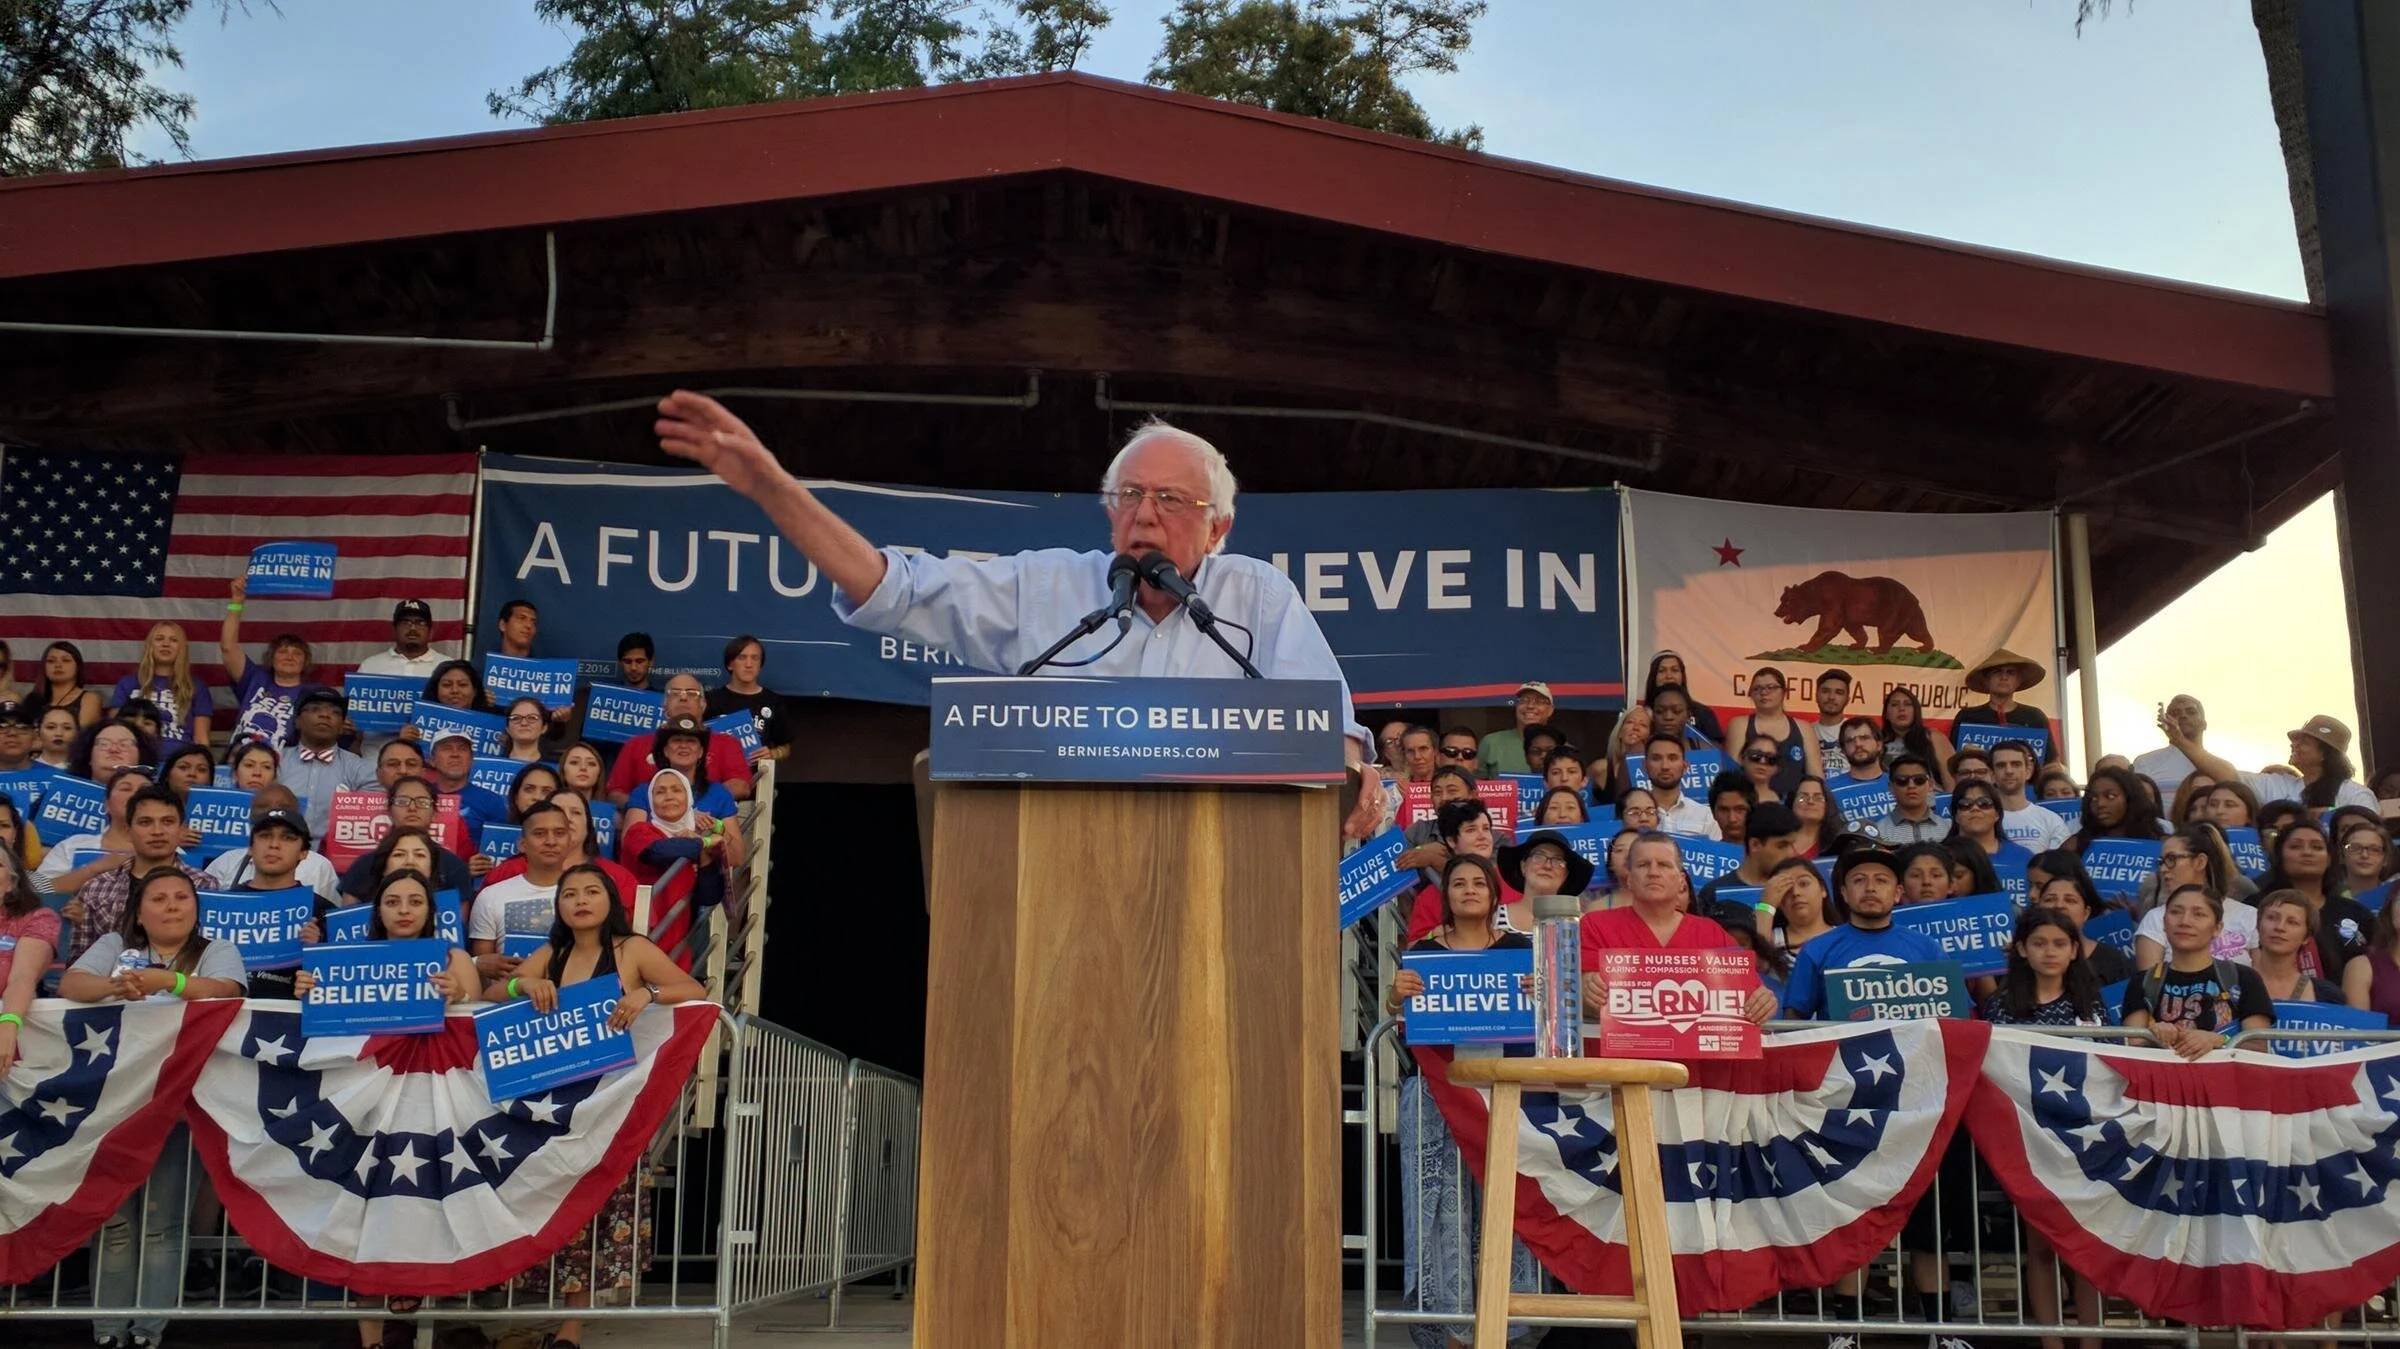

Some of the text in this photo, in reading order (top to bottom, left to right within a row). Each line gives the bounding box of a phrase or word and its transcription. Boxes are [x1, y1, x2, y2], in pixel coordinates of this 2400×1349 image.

[260, 553, 310, 566] FUTURE
[314, 555, 332, 566] TO
[515, 522, 571, 584] A
[1506, 548, 1596, 612] IN
[247, 565, 331, 579] BELIEVE IN
[489, 665, 572, 682] A FUTURE TO
[586, 664, 610, 674] 2016
[487, 676, 571, 695] BELIEVE IN
[349, 687, 359, 697] A
[361, 688, 413, 701] FUTURE
[347, 699, 412, 714] BELIEVE
[593, 696, 602, 707] A
[605, 698, 654, 716] FUTURE
[416, 715, 425, 726] A
[590, 707, 654, 729] BELIEVE
[945, 705, 1329, 731] A FUTURE TO BELIEVE IN
[735, 723, 752, 736] TO
[740, 734, 757, 749] IN
[1963, 733, 1971, 741] A
[2028, 739, 2043, 747] TO
[483, 743, 501, 756] IN
[1057, 745, 1220, 759] BERNIESANDERS.COM
[473, 769, 482, 780] A
[1700, 763, 1719, 774] TO
[49, 791, 61, 803] A
[337, 796, 364, 804] VOTE
[1842, 791, 1896, 808] FUTURE
[192, 804, 250, 819] A FUTU
[1844, 802, 1897, 822] ELIEVE
[486, 841, 496, 852] A
[1384, 842, 1403, 858] TO
[1719, 856, 1740, 869] TO
[2086, 852, 2153, 868] A FUTURE
[2086, 866, 2149, 882] BELIEVE
[1339, 865, 1390, 905] ELIEVE
[207, 906, 308, 924] FUTURE TO
[1982, 913, 2009, 928] TO
[335, 929, 347, 942] A
[1989, 929, 2013, 947] IN
[2108, 928, 2131, 944] TO
[1605, 955, 1749, 966] VOTE NURSES' VALUES
[311, 961, 442, 983] A FUTURE TO
[1605, 966, 1749, 975] CARING COMPASSION COMMUNITY
[1430, 974, 1507, 990] FUTURE
[1609, 980, 1652, 988] NURSES FOR
[1843, 973, 1949, 1001] Unidos
[2164, 983, 2189, 996] NOT
[309, 982, 441, 1005] BELIEVE IN
[1609, 988, 1746, 1015] BERNIE!
[1411, 993, 1513, 1014] BELIEVE
[1872, 997, 1952, 1020] Bernie
[2160, 993, 2203, 1022] US
[486, 999, 618, 1048] A FUTURE TO
[489, 1026, 591, 1070] BELIEVE
